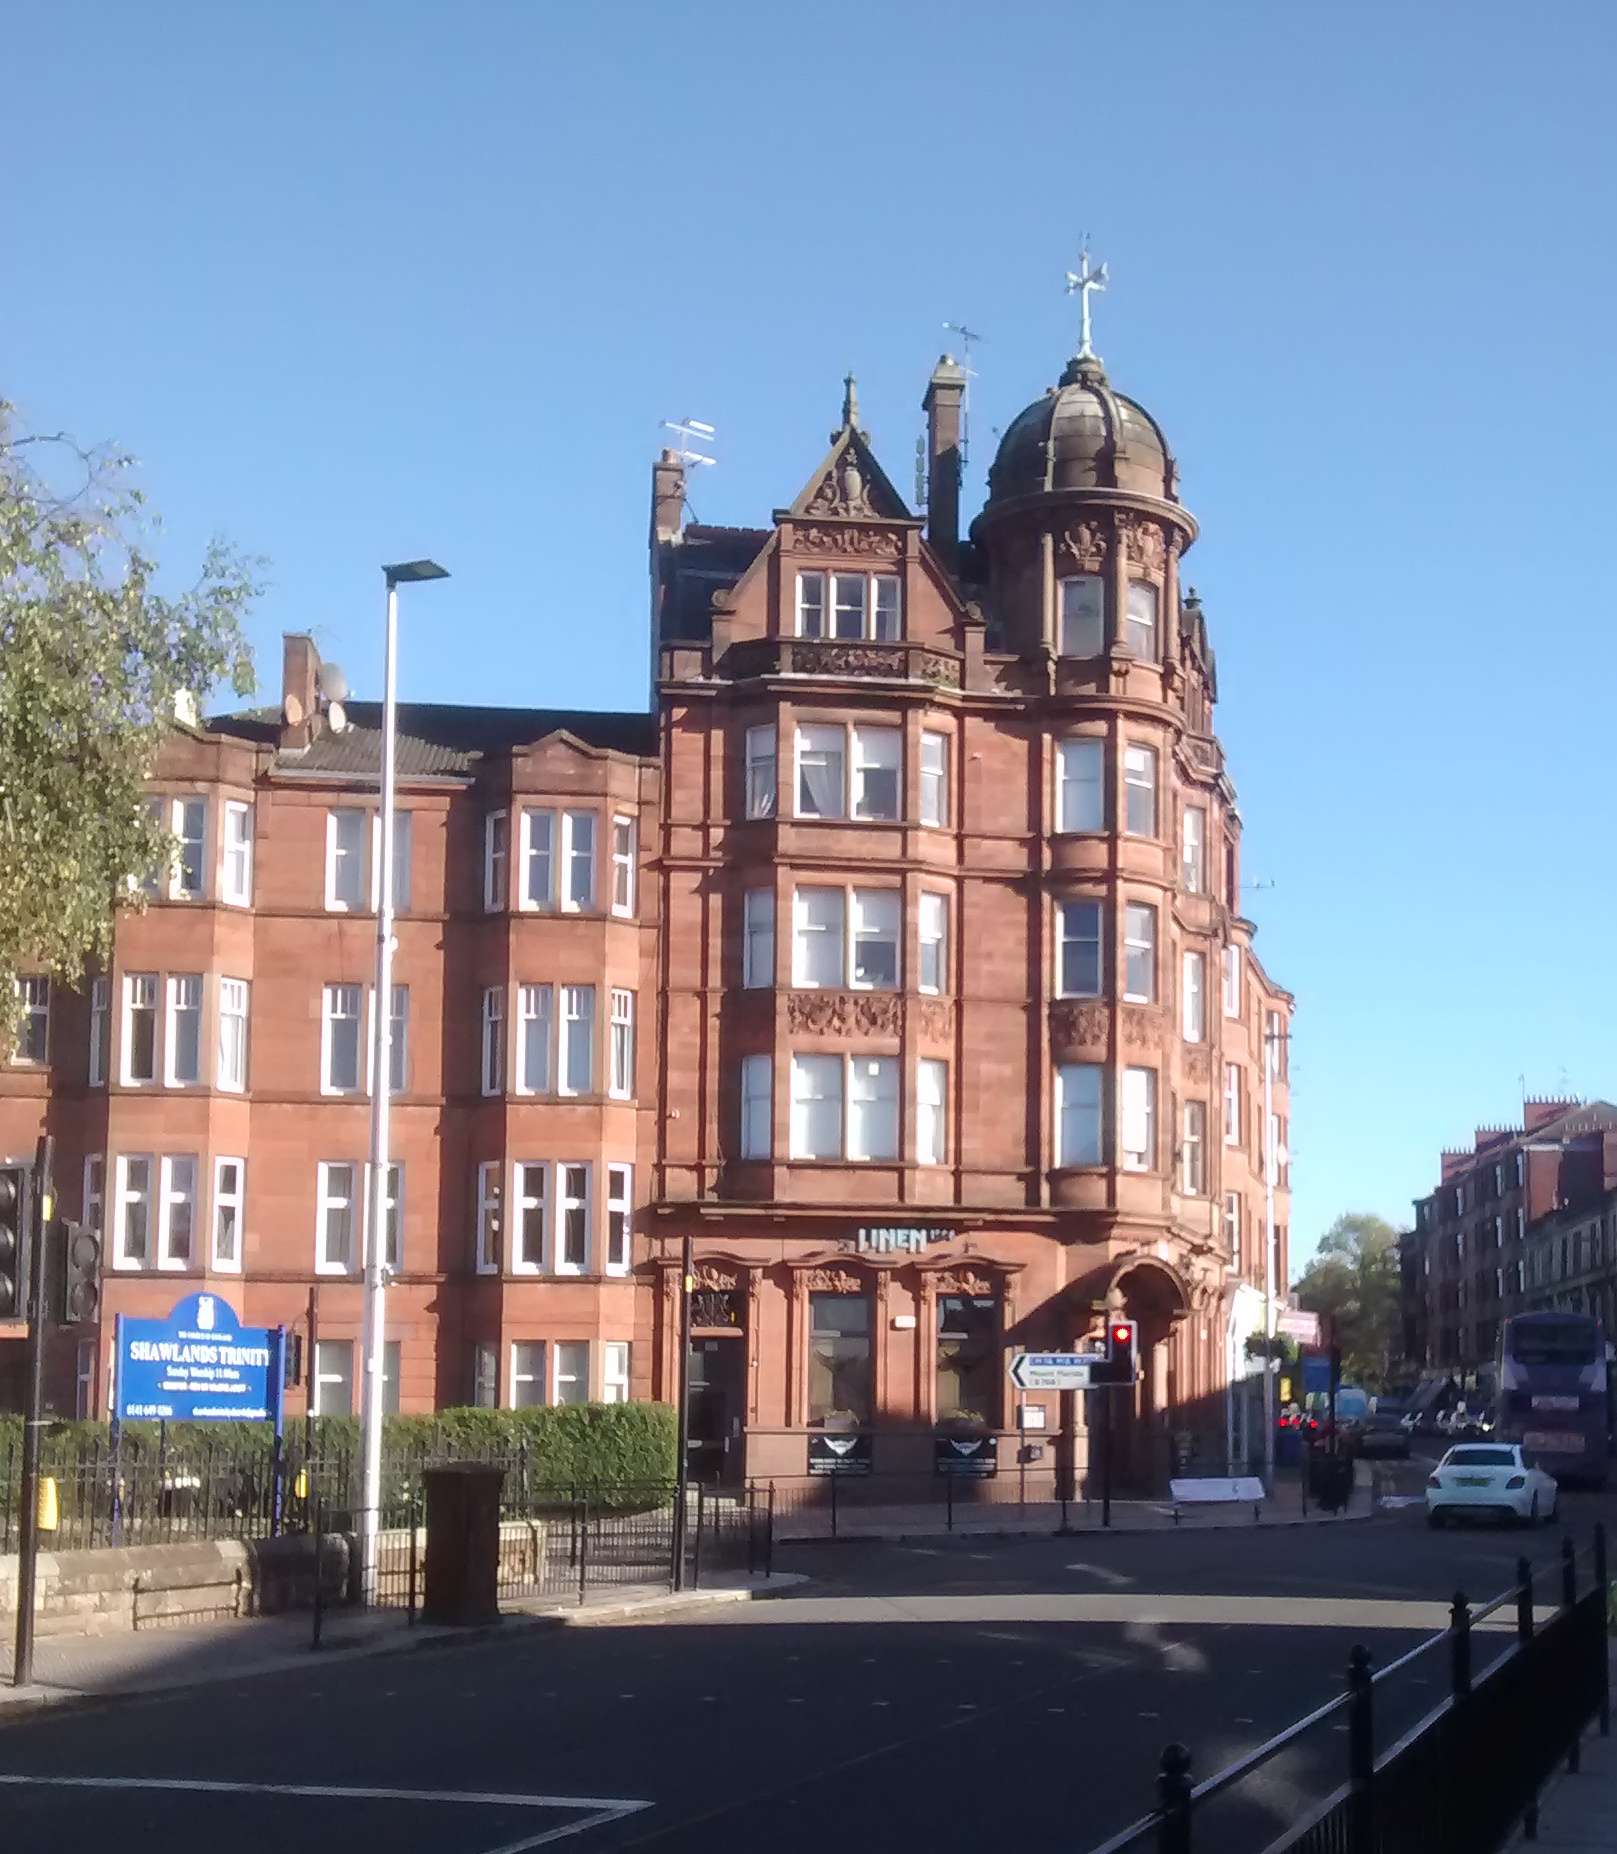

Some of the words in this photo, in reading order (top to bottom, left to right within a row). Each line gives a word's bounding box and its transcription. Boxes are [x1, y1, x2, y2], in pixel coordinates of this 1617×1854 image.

[859, 1228, 927, 1252] LINEN
[130, 1341, 217, 1364] SHAWLANDS
[218, 1346, 270, 1367] TRINITY
